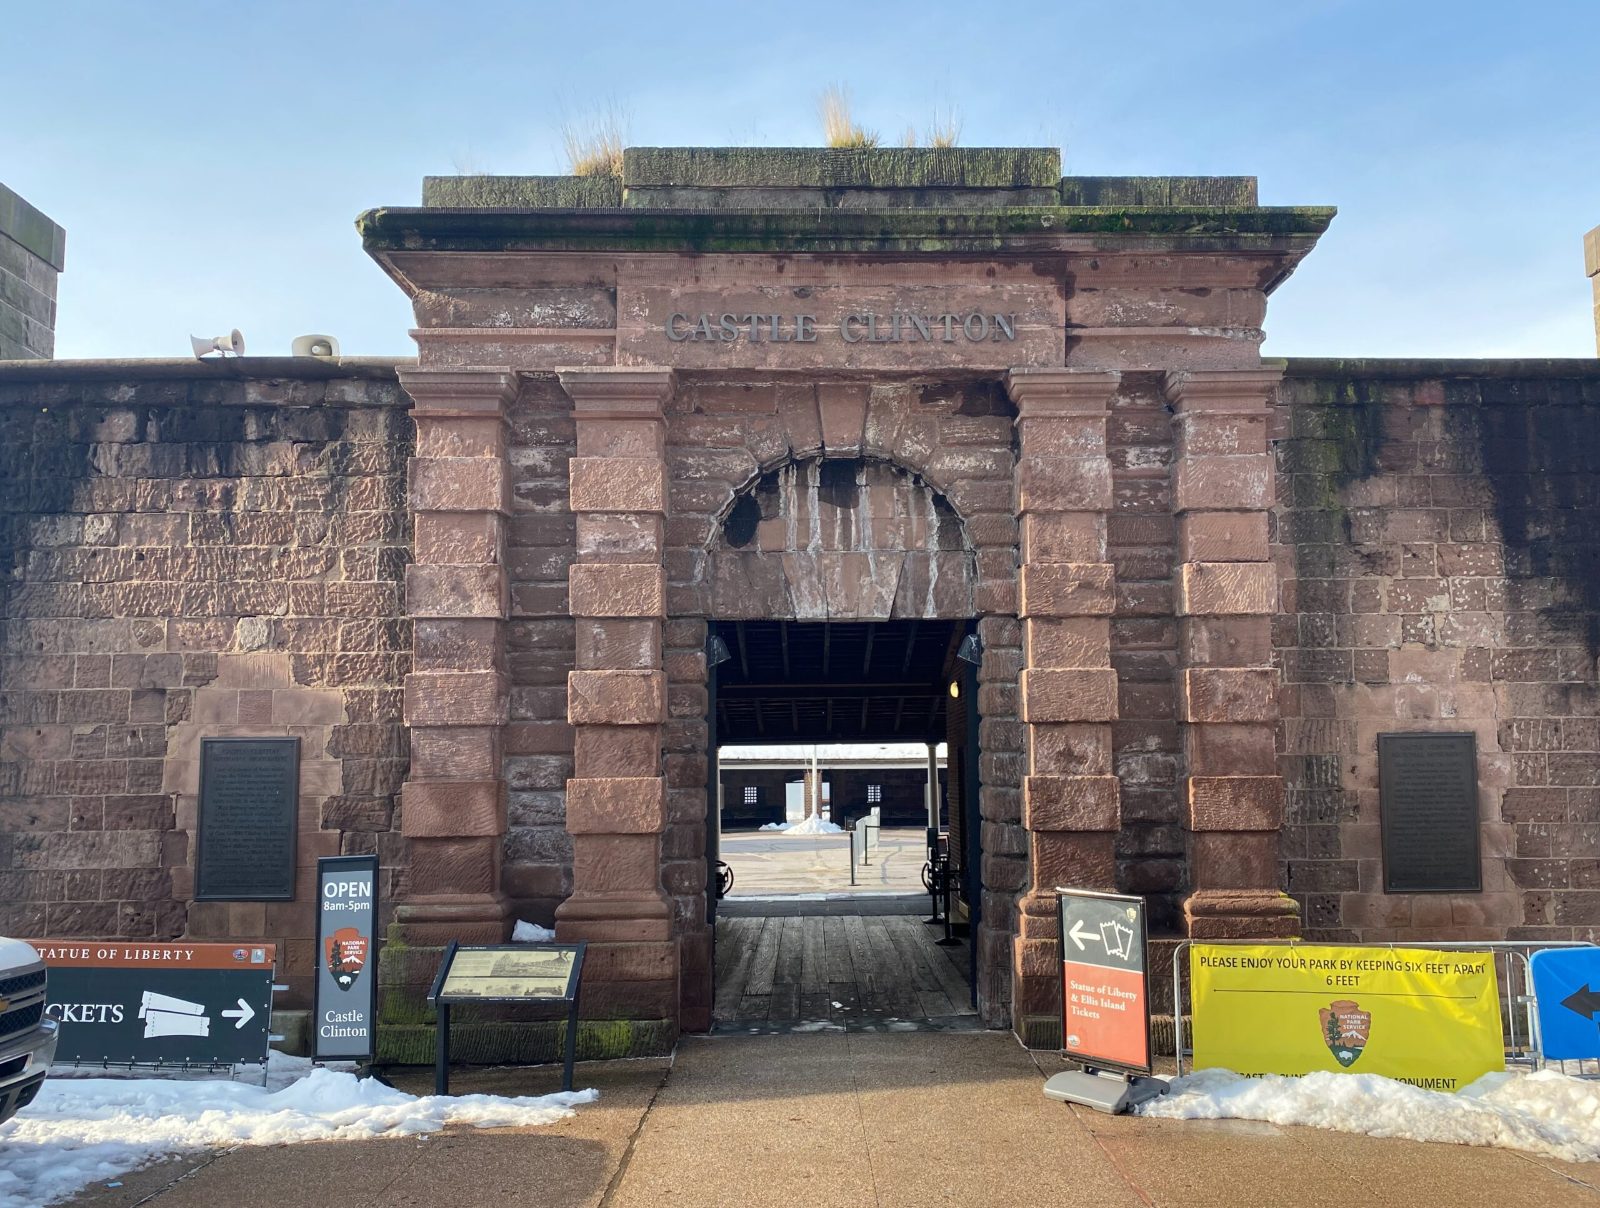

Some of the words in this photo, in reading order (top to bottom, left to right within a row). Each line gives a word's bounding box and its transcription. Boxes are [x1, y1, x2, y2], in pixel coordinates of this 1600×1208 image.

[665, 312, 818, 343] CASTLE
[839, 312, 1018, 343] CLINTON
[324, 881, 370, 898] OPEN
[323, 900, 370, 912] 8am-5pm
[38, 948, 90, 959] TATUE
[97, 949, 118, 960] OF
[124, 949, 194, 960] LIBERTY
[1200, 956, 1238, 968] PLEASE
[1241, 957, 1273, 969] ENJOY
[1276, 958, 1307, 969] YOUR
[1309, 959, 1337, 970] PARK
[1340, 959, 1353, 970] BY
[1356, 961, 1403, 972] KEEPING
[1405, 961, 1423, 972] SIX
[1425, 963, 1450, 974] FEET
[1326, 975, 1333, 986] 6
[1336, 975, 1360, 986] FEET
[1070, 980, 1095, 993] Statue
[1097, 985, 1107, 994] of
[1108, 986, 1137, 1002] Liberty
[1071, 994, 1078, 1002] &
[1081, 994, 1099, 1006] Ellis
[1101, 998, 1126, 1011] Island
[44, 1004, 124, 1023] CKETS
[325, 1010, 364, 1023] Castle
[1071, 1005, 1100, 1019] Tickets
[320, 1025, 367, 1037] Clinton
[1394, 1077, 1457, 1089] ONUMENT
